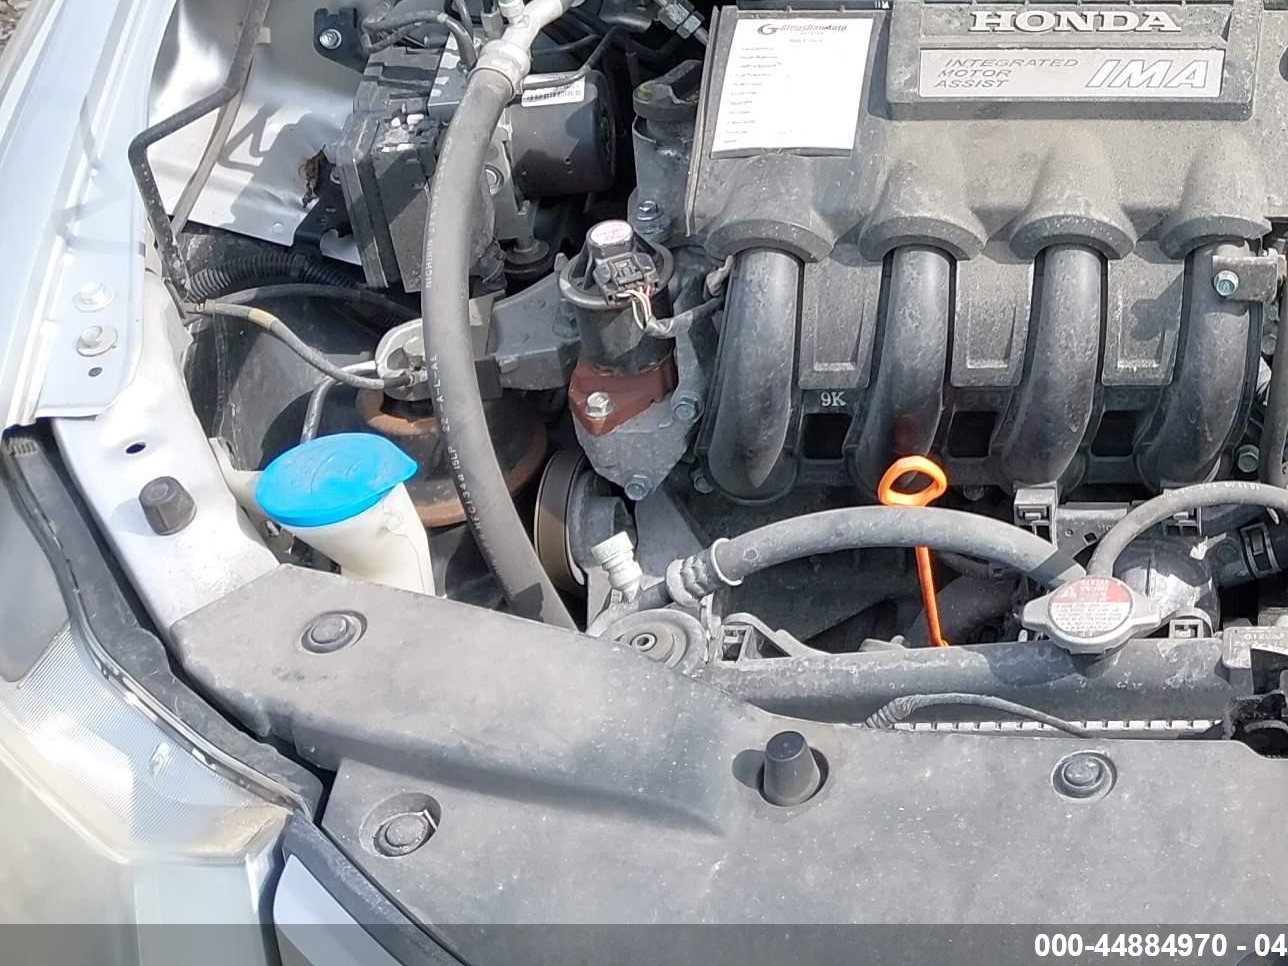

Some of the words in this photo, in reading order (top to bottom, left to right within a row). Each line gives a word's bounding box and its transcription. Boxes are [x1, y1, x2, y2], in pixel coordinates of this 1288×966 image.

[968, 9, 1183, 33] HONDA
[945, 58, 1079, 68] INTEGRATED
[937, 69, 1012, 78] MOTOR
[1085, 58, 1210, 89] IMA
[934, 79, 1009, 89] ASSIST
[820, 391, 847, 407] 9K
